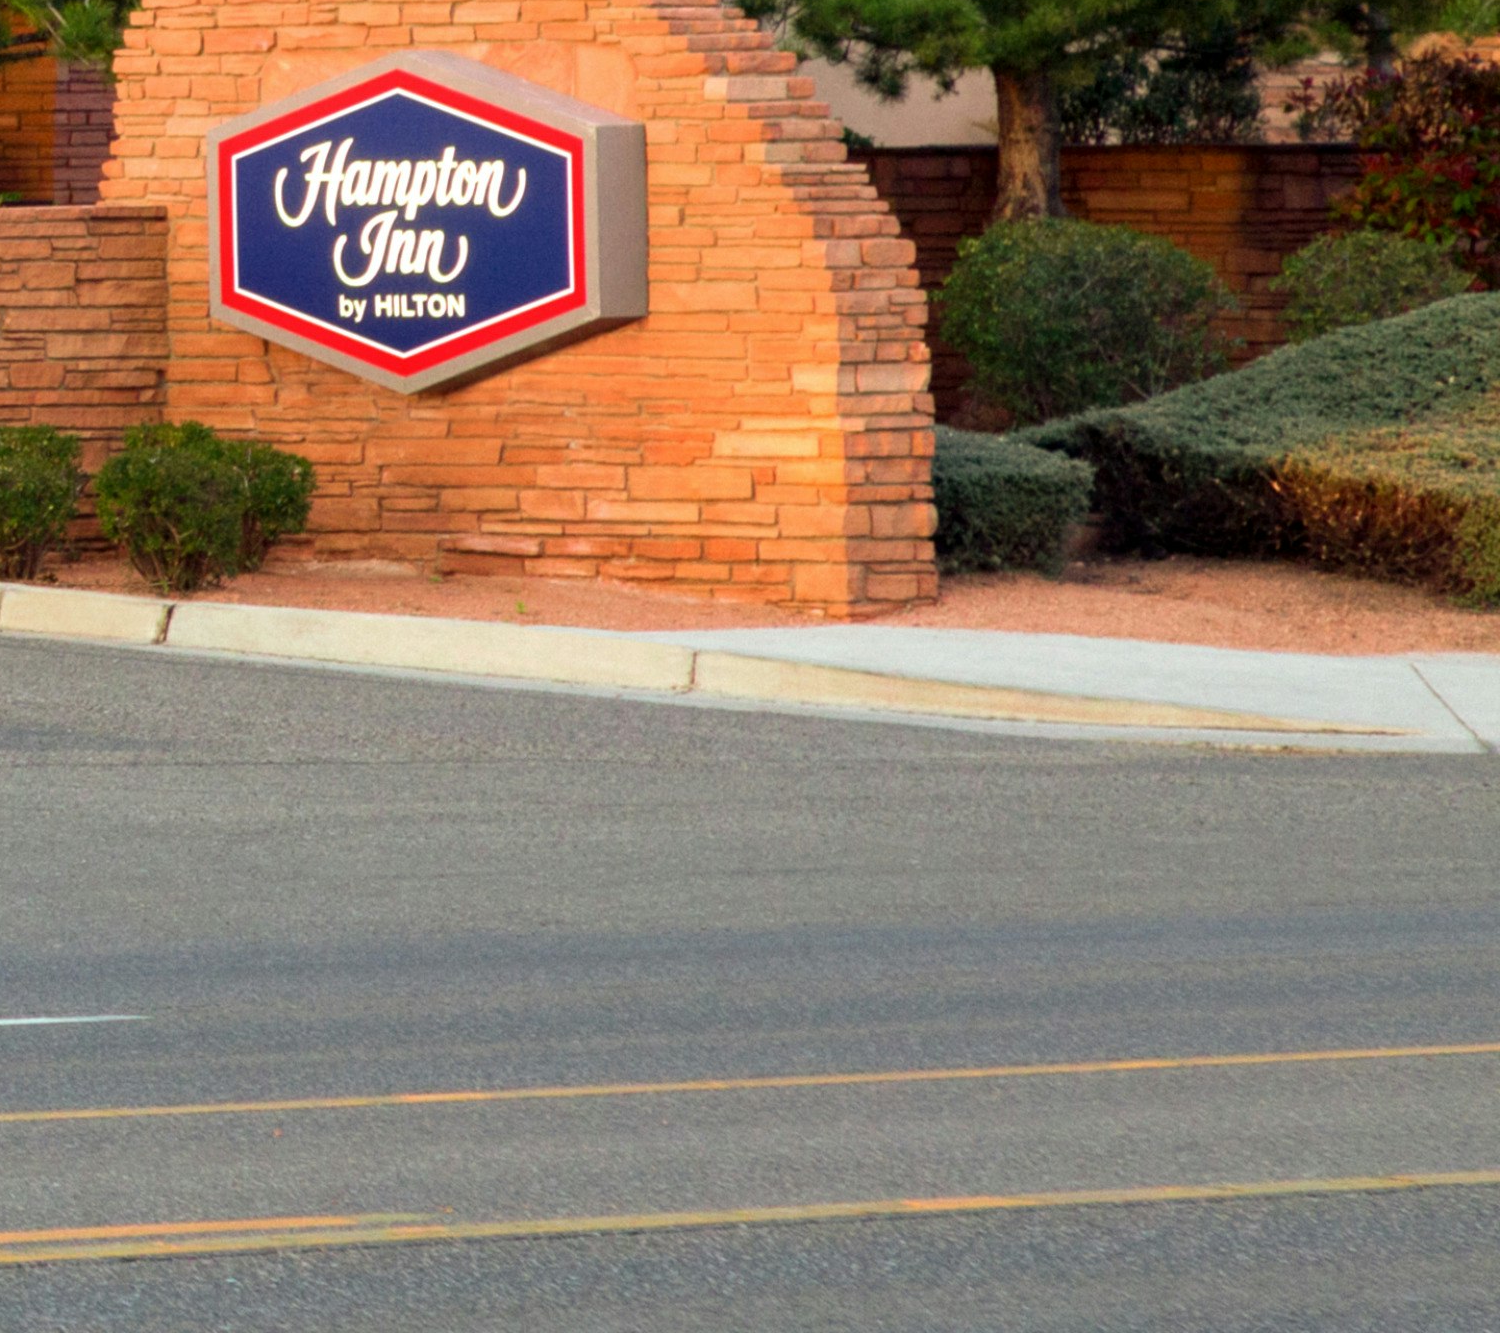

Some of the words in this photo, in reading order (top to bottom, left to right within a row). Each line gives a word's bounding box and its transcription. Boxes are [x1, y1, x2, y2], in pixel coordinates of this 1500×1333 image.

[275, 137, 527, 227] Hampton
[333, 210, 468, 287] Inn
[338, 294, 367, 323] by
[374, 294, 466, 318] HILTON
